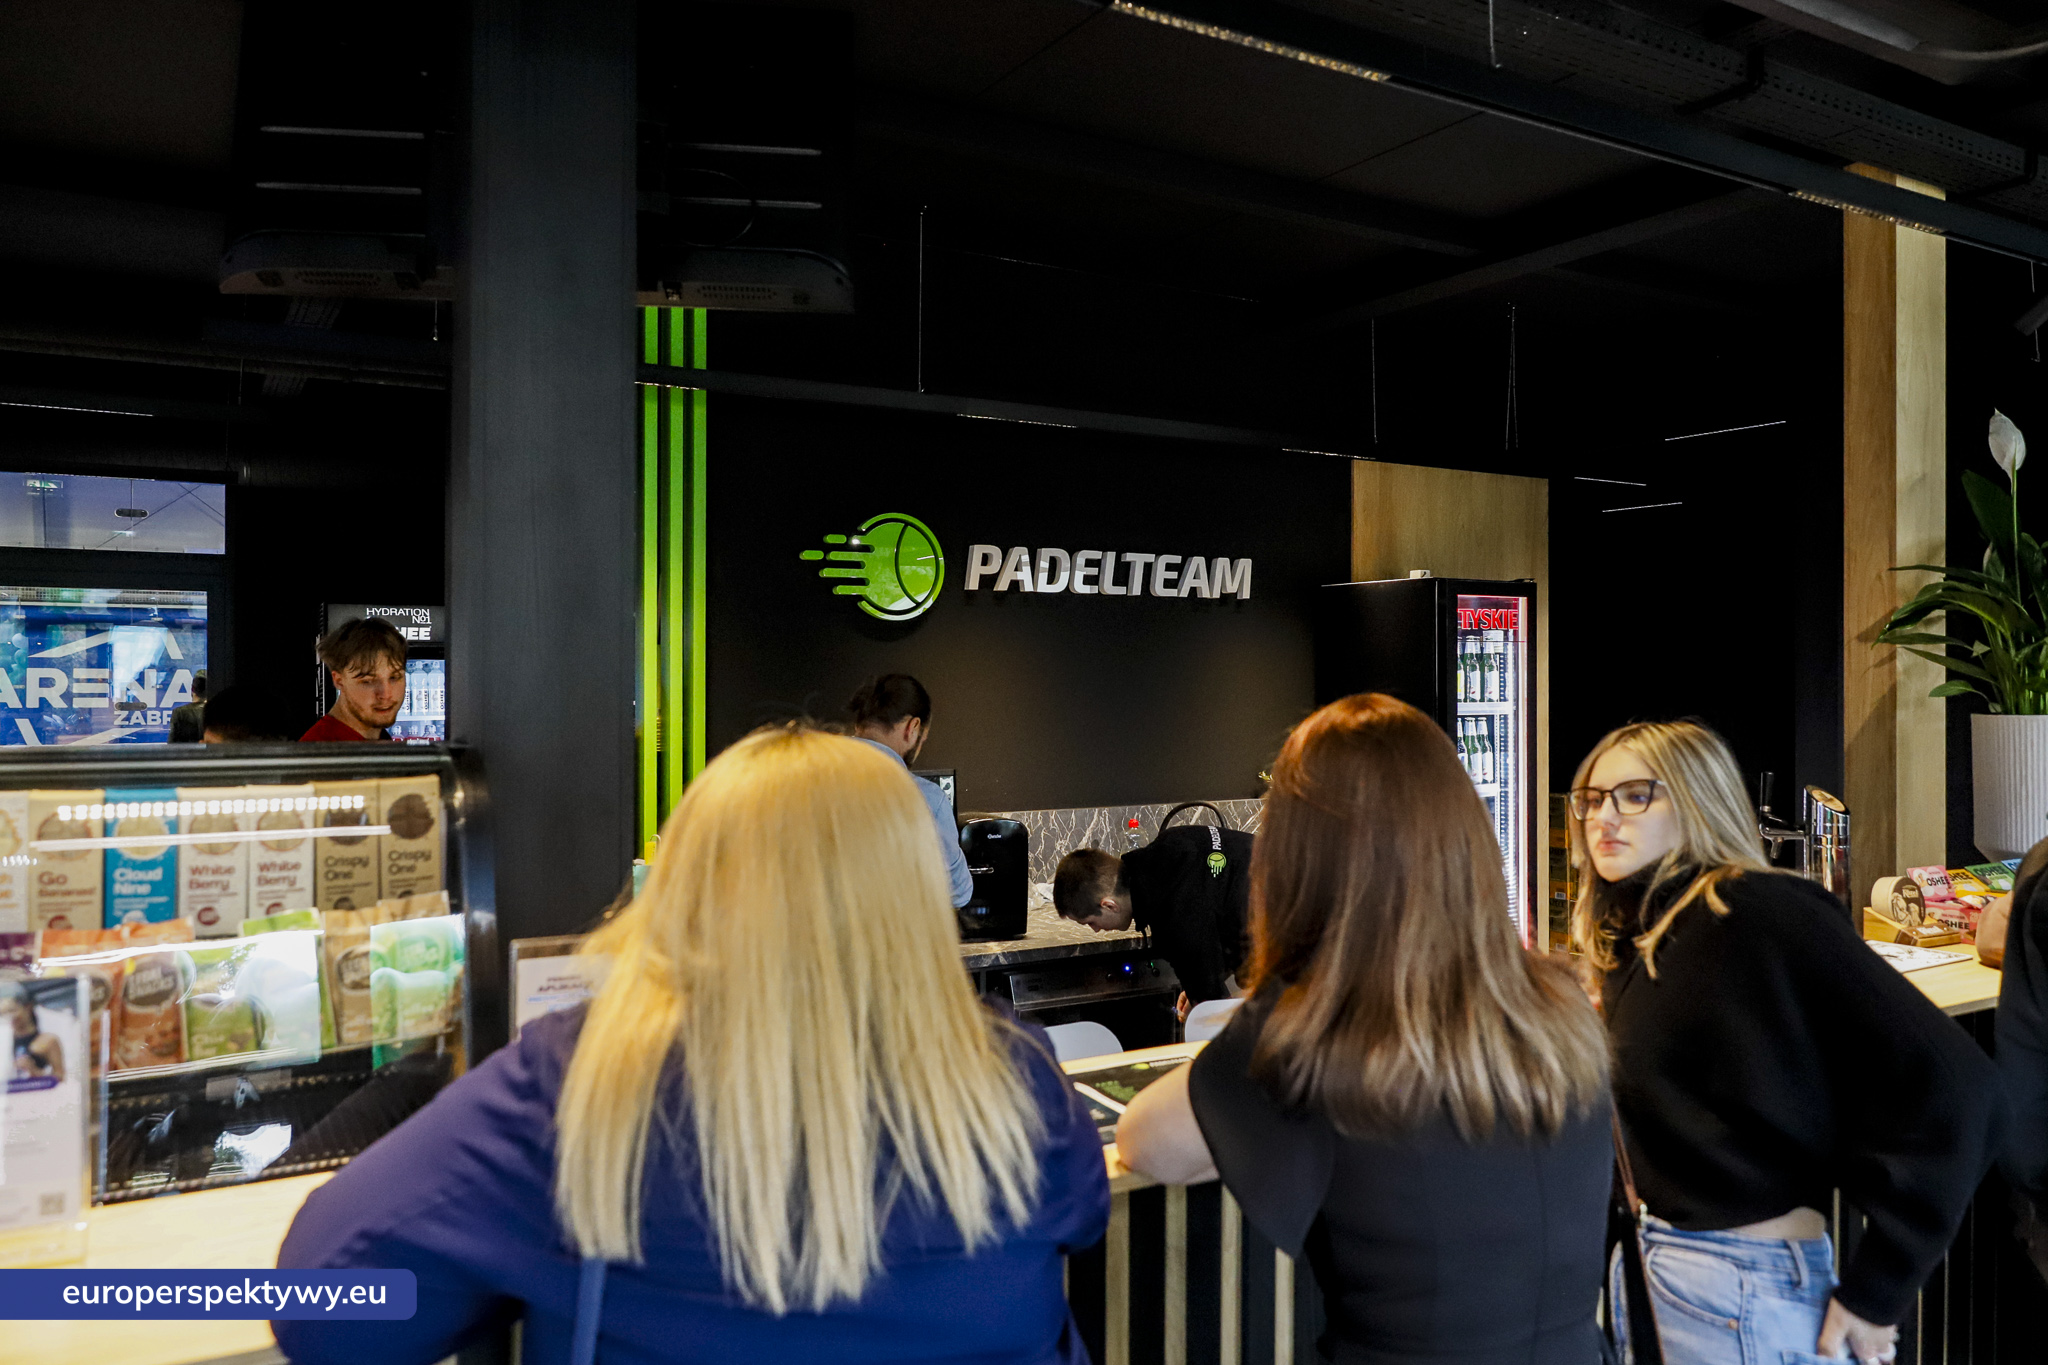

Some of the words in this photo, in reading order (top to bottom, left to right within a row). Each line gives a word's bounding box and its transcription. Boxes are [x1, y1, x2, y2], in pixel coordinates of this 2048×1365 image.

[965, 544, 1252, 599] PADELTEAM
[366, 607, 430, 617] HYDRATION
[1458, 608, 1519, 630] TYSKIE
[0, 667, 193, 709] ARENA
[38, 871, 68, 886] Go
[112, 866, 164, 882] Cloud
[257, 873, 298, 888] Berry
[112, 882, 152, 896] Nine
[187, 878, 231, 893] Berry
